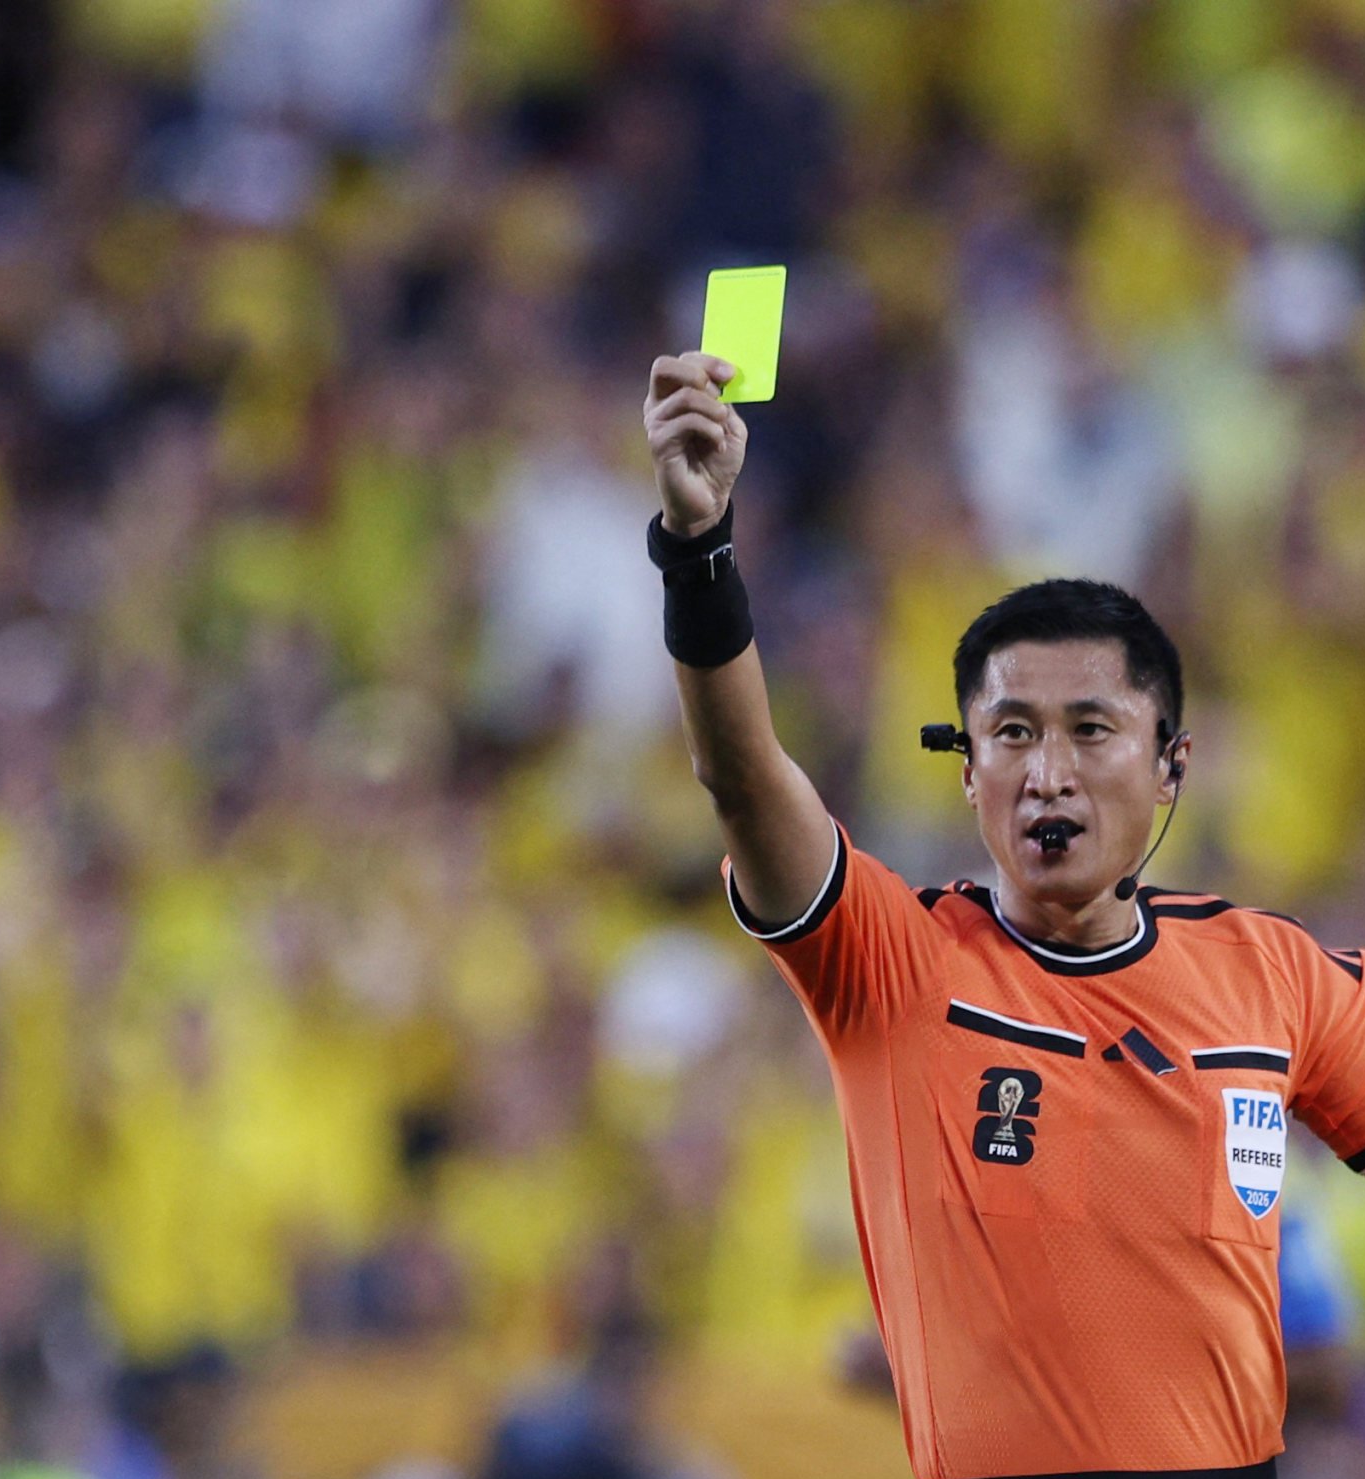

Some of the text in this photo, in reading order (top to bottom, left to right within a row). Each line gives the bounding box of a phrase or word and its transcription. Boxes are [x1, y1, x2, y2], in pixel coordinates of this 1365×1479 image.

[1232, 1097, 1283, 1131] FIFA
[988, 1142, 1018, 1157] FIFA
[1232, 1147, 1282, 1169] REFEREE
[1246, 1189, 1270, 1208] 2026
